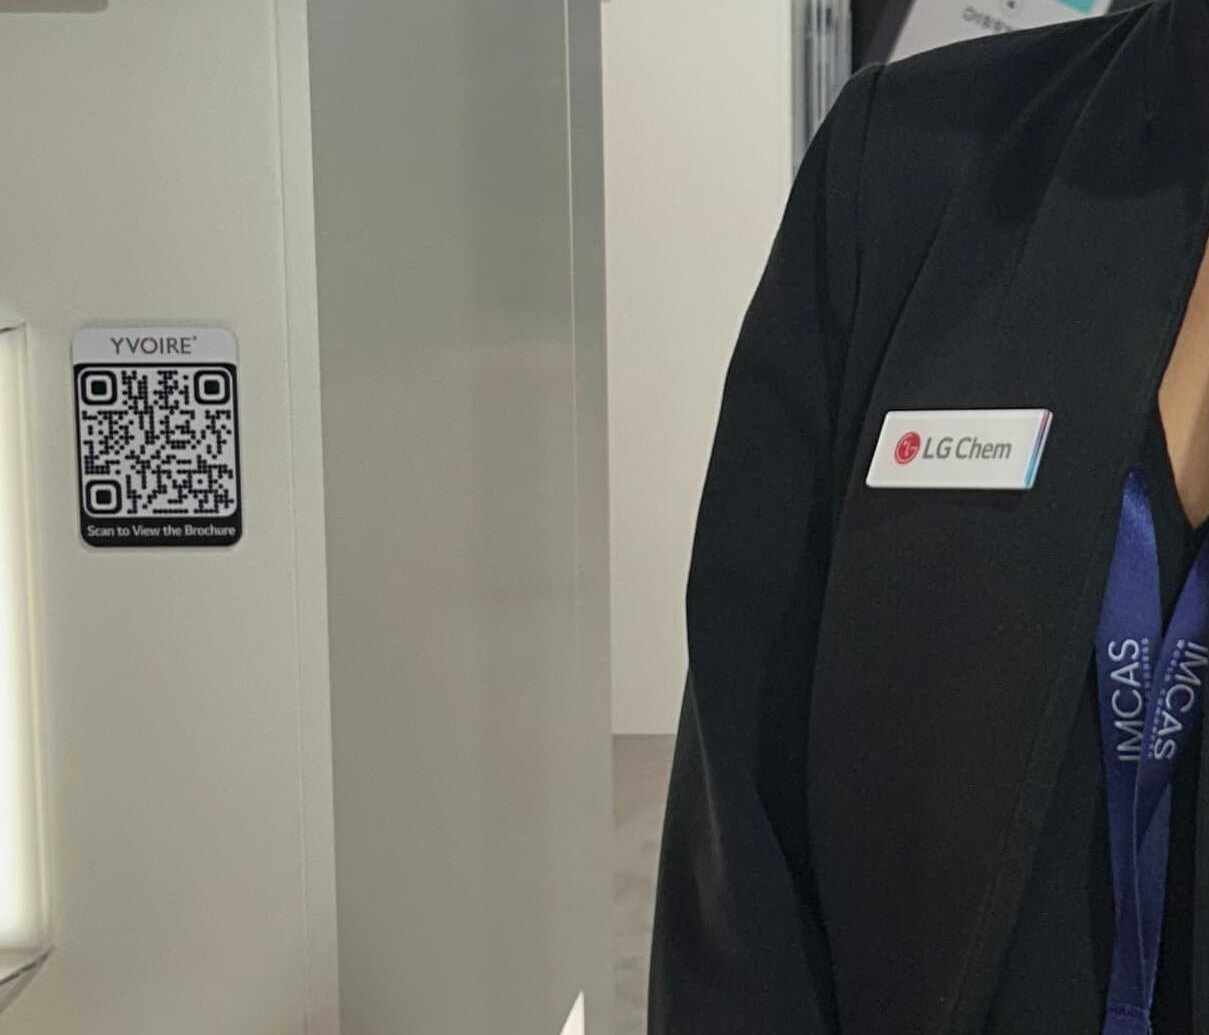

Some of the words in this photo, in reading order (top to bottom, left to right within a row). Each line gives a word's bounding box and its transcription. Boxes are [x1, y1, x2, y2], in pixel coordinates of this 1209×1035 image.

[922, 436, 954, 459] LG
[955, 436, 1012, 460] Chem
[87, 525, 115, 537] Scan
[117, 525, 130, 537] to
[132, 525, 160, 537] View
[163, 525, 182, 537] the
[184, 525, 236, 537] Brochure
[1108, 638, 1143, 761] IMCAS
[1153, 641, 1209, 760] IMCAS
